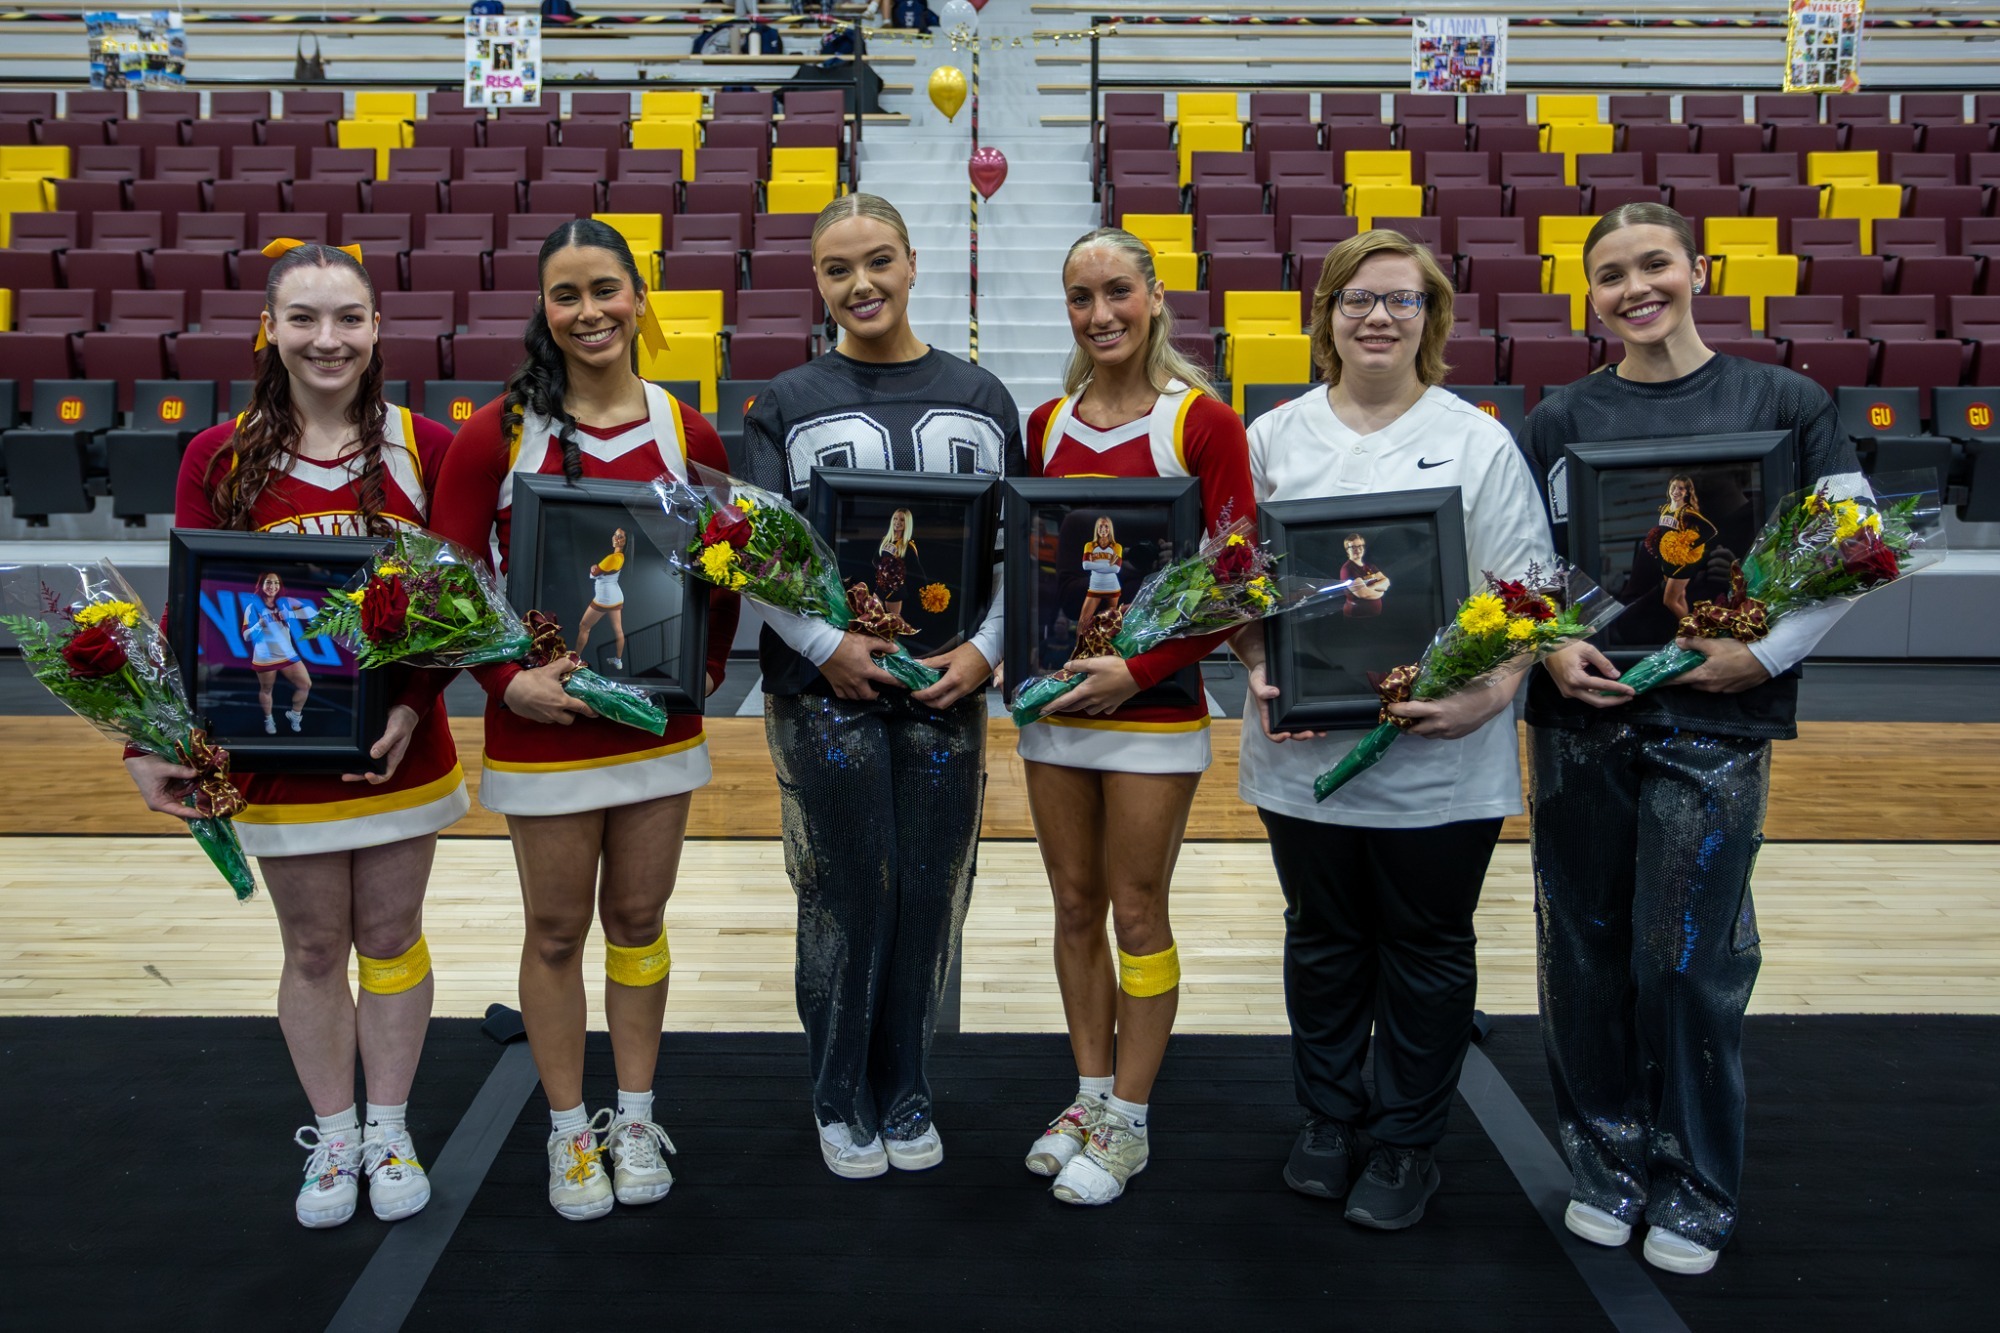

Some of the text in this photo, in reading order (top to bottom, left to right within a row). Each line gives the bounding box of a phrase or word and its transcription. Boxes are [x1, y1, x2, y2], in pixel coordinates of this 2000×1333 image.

[485, 75, 523, 88] RISA
[61, 401, 81, 420] GU
[162, 401, 182, 420] GU
[453, 401, 472, 420] GU
[1871, 407, 1891, 426] GU
[1969, 407, 1989, 426] GU
